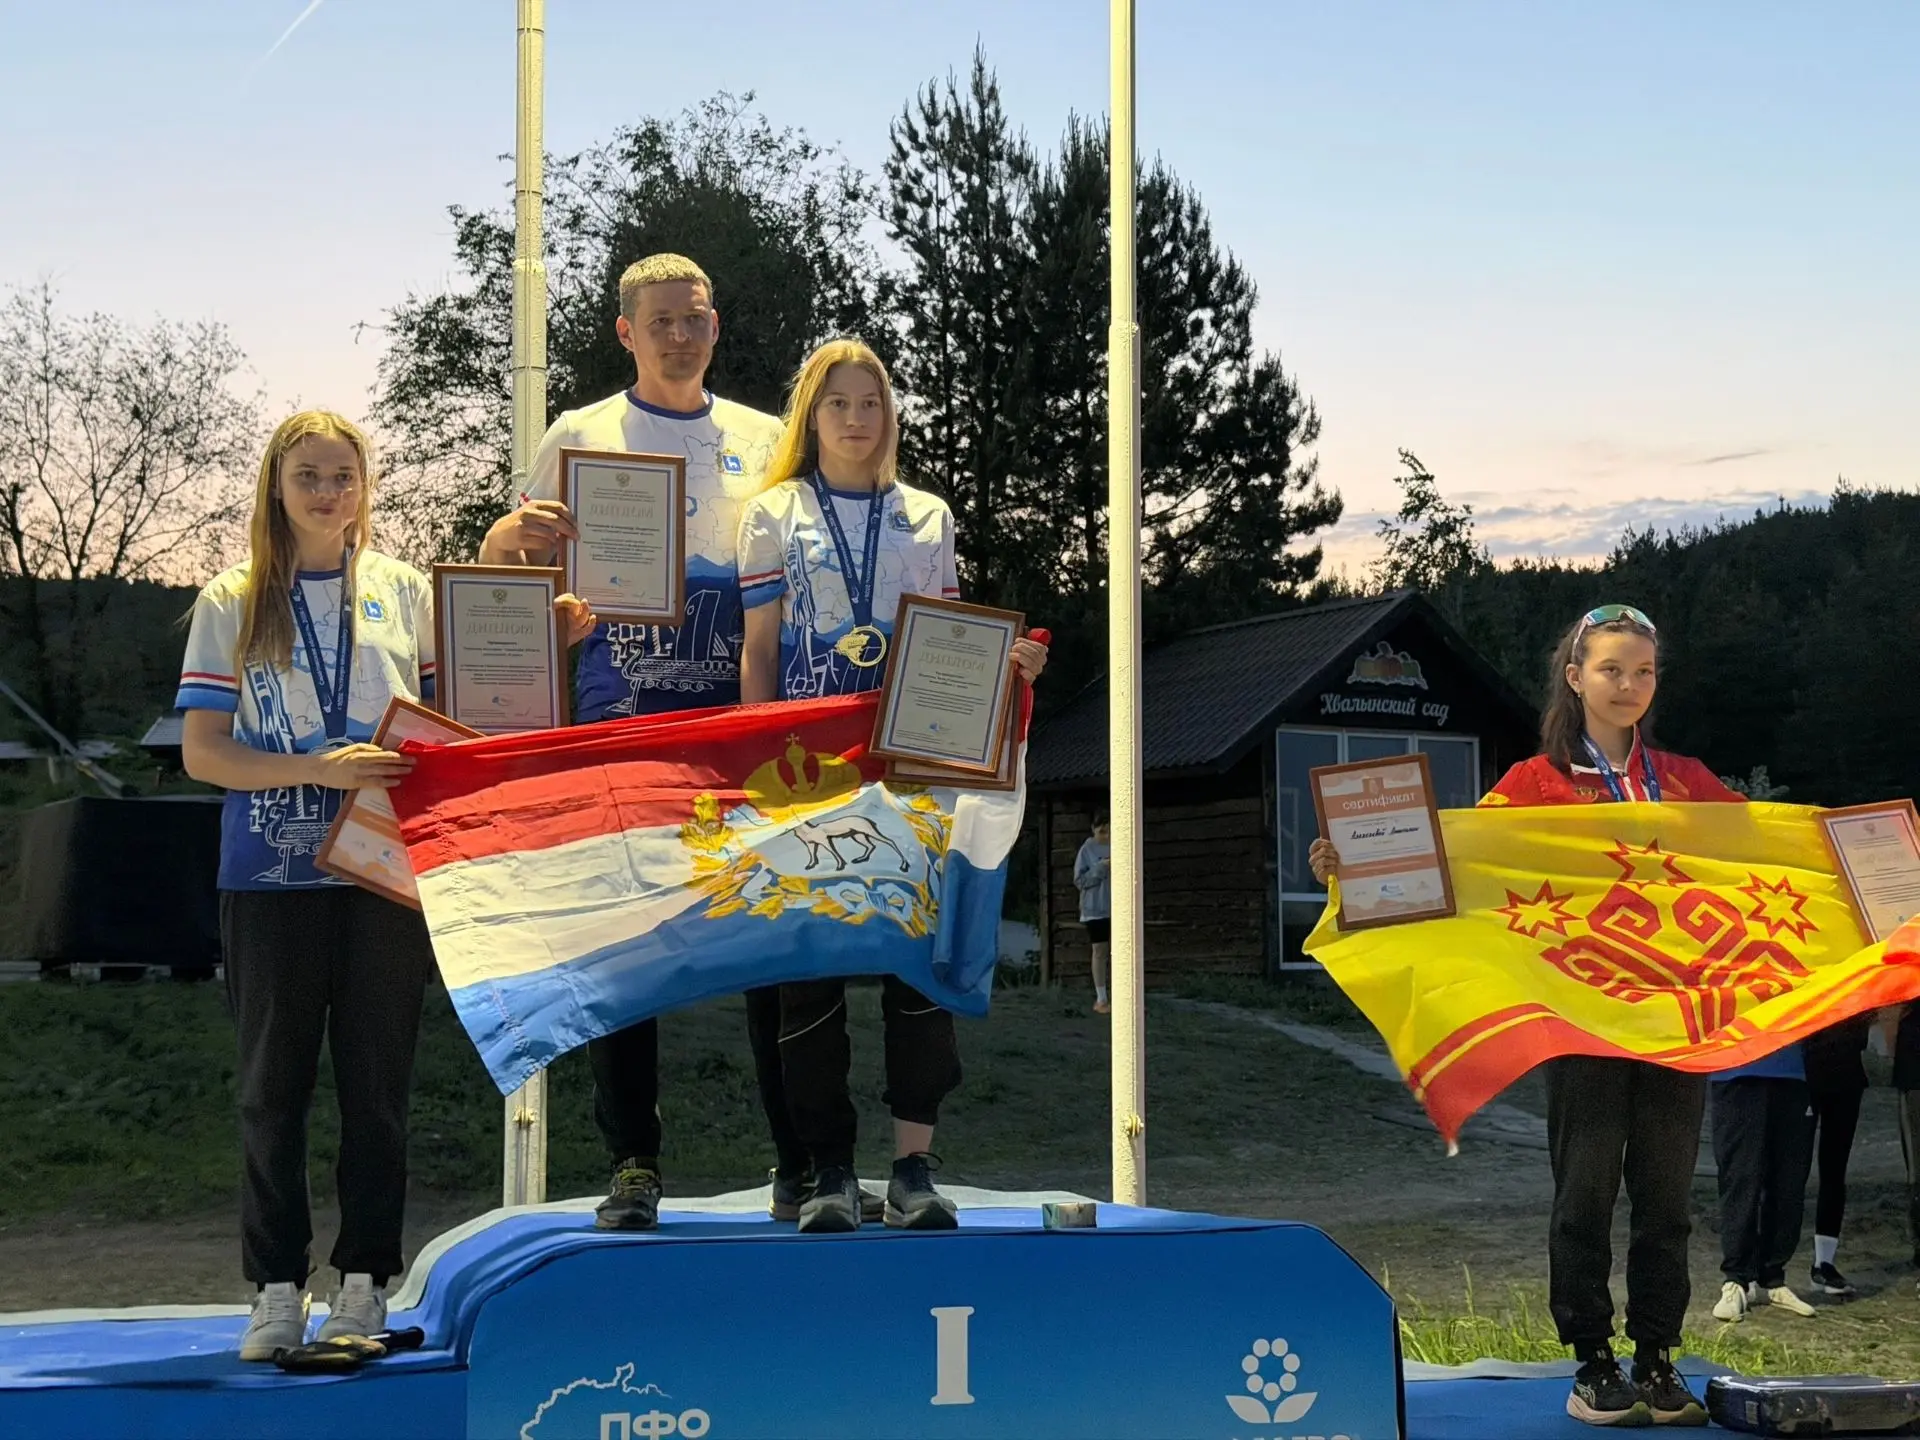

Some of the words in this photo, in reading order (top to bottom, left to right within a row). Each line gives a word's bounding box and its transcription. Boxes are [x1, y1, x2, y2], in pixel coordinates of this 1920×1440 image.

[918, 651, 986, 672] ДИПЛОМ
[1320, 692, 1416, 716] Хвалынский
[1421, 701, 1449, 726] сад
[600, 1408, 711, 1440] ПФО
